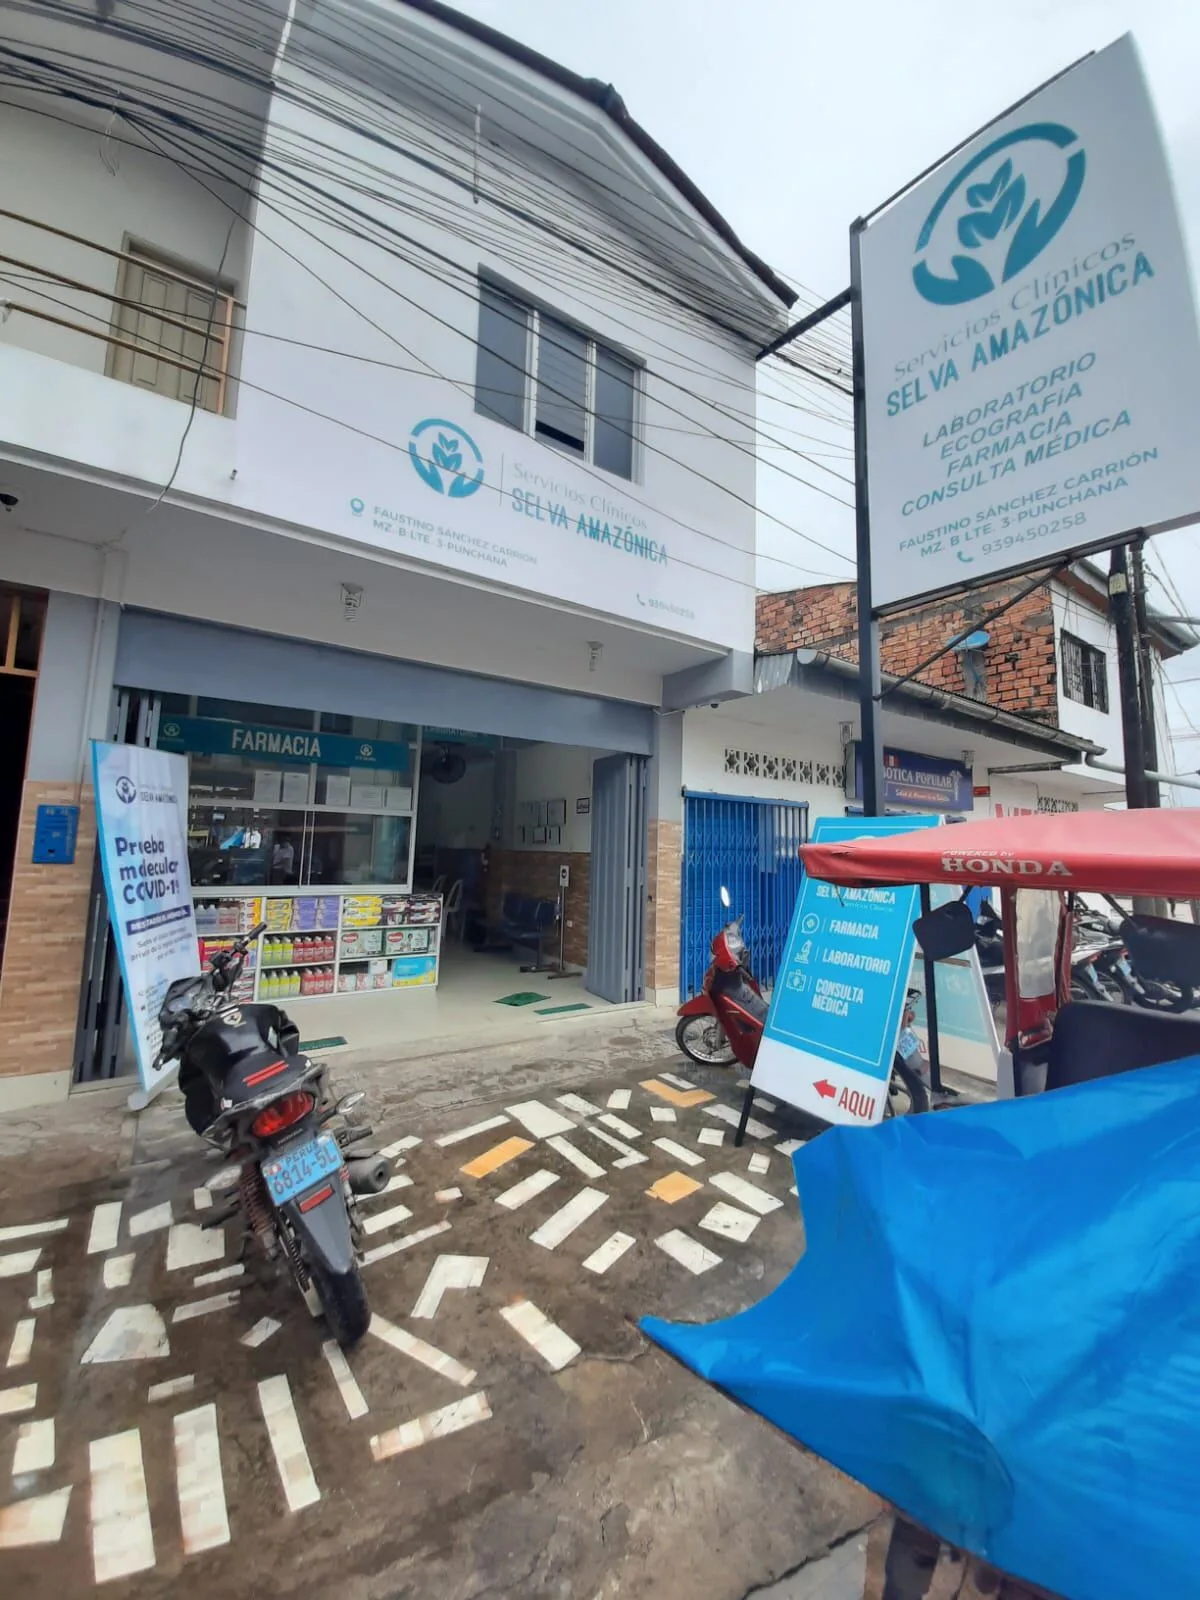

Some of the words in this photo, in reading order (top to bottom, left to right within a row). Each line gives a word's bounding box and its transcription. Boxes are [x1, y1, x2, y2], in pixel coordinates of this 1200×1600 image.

[894, 308, 1001, 380] Servicios
[1011, 232, 1136, 310] Clínicos
[887, 357, 960, 417] SELVA
[971, 251, 1155, 372] AMAZÓNICA
[923, 352, 1097, 448] LABORATORIO
[901, 457, 1016, 517] CONSULTA
[1023, 410, 1131, 467] MÉDICA
[947, 411, 1072, 478] FARMACIA
[513, 462, 586, 506] Servicios
[900, 517, 971, 551] FAUSTINO
[976, 485, 1058, 523] SÁNCHEZ
[1064, 447, 1159, 490] CARRIÓN
[373, 506, 434, 532] FAUSTINO
[511, 487, 569, 530] SELVA
[576, 513, 669, 567] AMAZÓNICA
[981, 511, 1087, 555] 939450258
[232, 728, 321, 758] FARMACIA
[915, 772, 953, 788] POPULAR
[941, 858, 1073, 876] HONDA
[123, 878, 180, 905] COVID-1
[829, 919, 879, 940] FARMACIA
[822, 949, 891, 976] LABORATORIO
[815, 979, 864, 1003] CONSULTA
[838, 1086, 876, 1121] AQUI
[273, 1145, 336, 1194] 6814-5L
